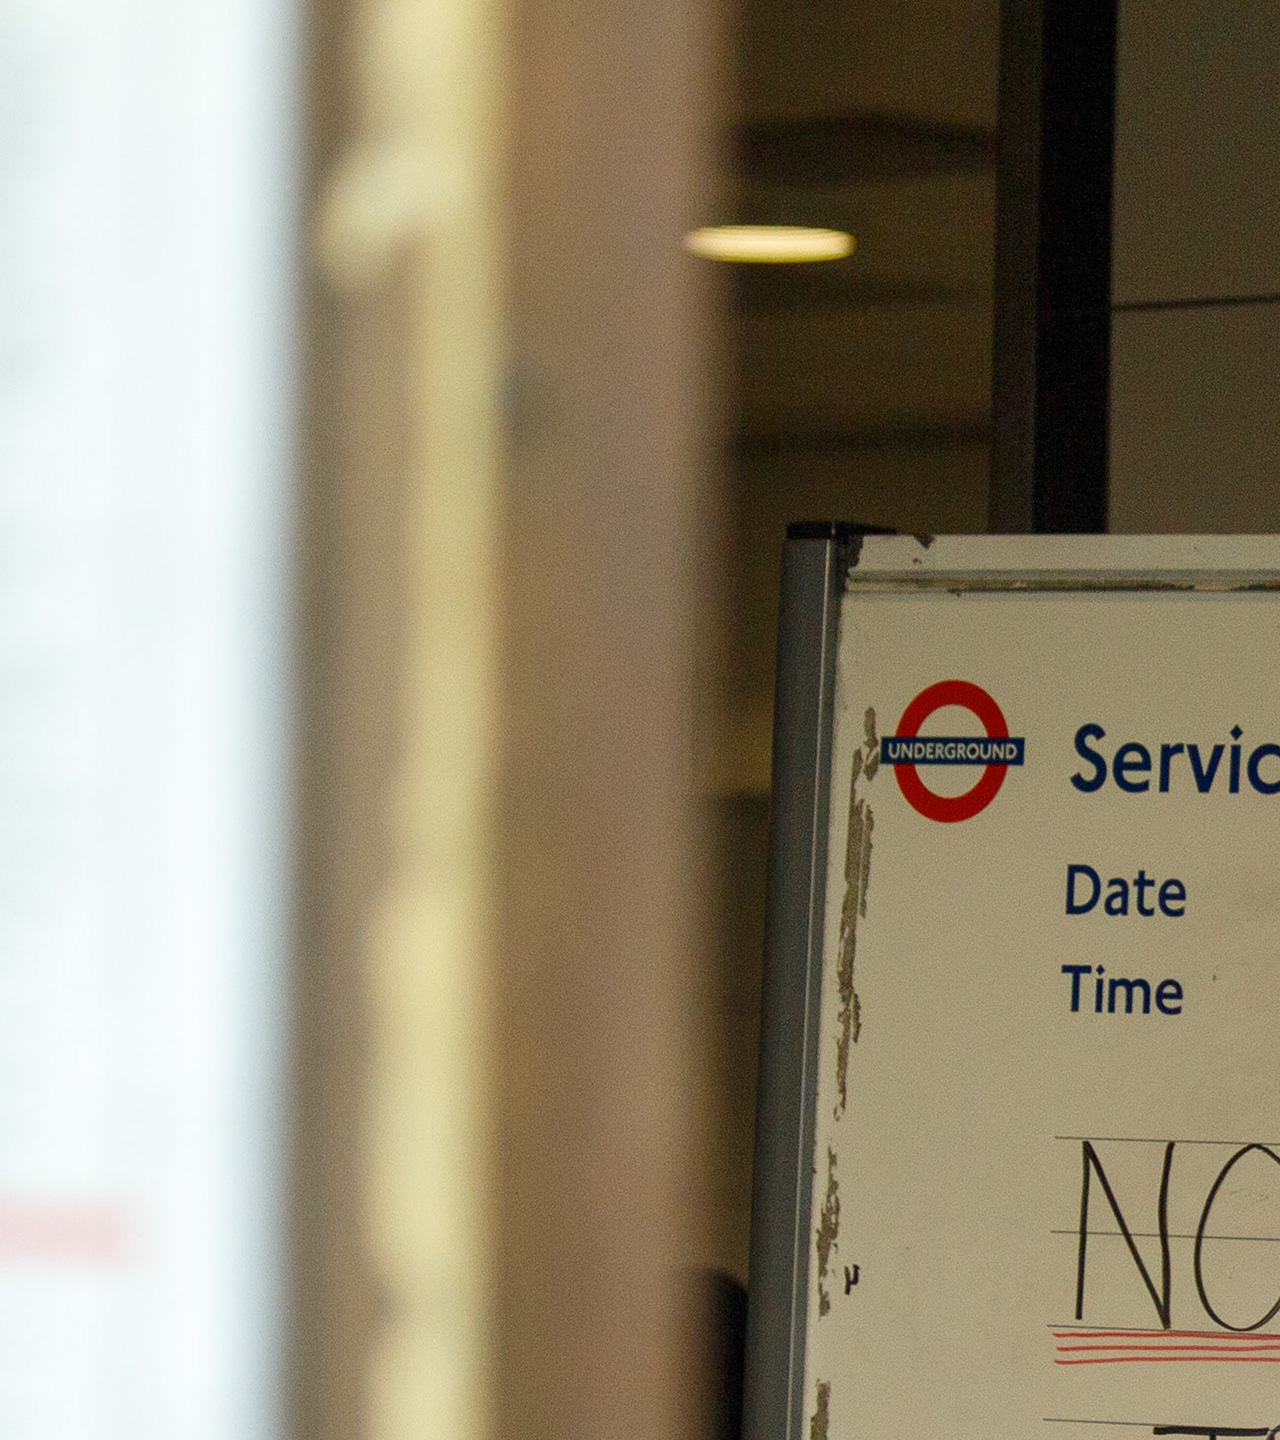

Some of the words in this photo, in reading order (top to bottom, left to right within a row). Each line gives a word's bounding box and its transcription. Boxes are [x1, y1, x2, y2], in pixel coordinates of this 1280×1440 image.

[887, 742, 1018, 761] UNDERGROUND
[1065, 863, 1187, 918] Date
[1061, 964, 1184, 1016] Time
